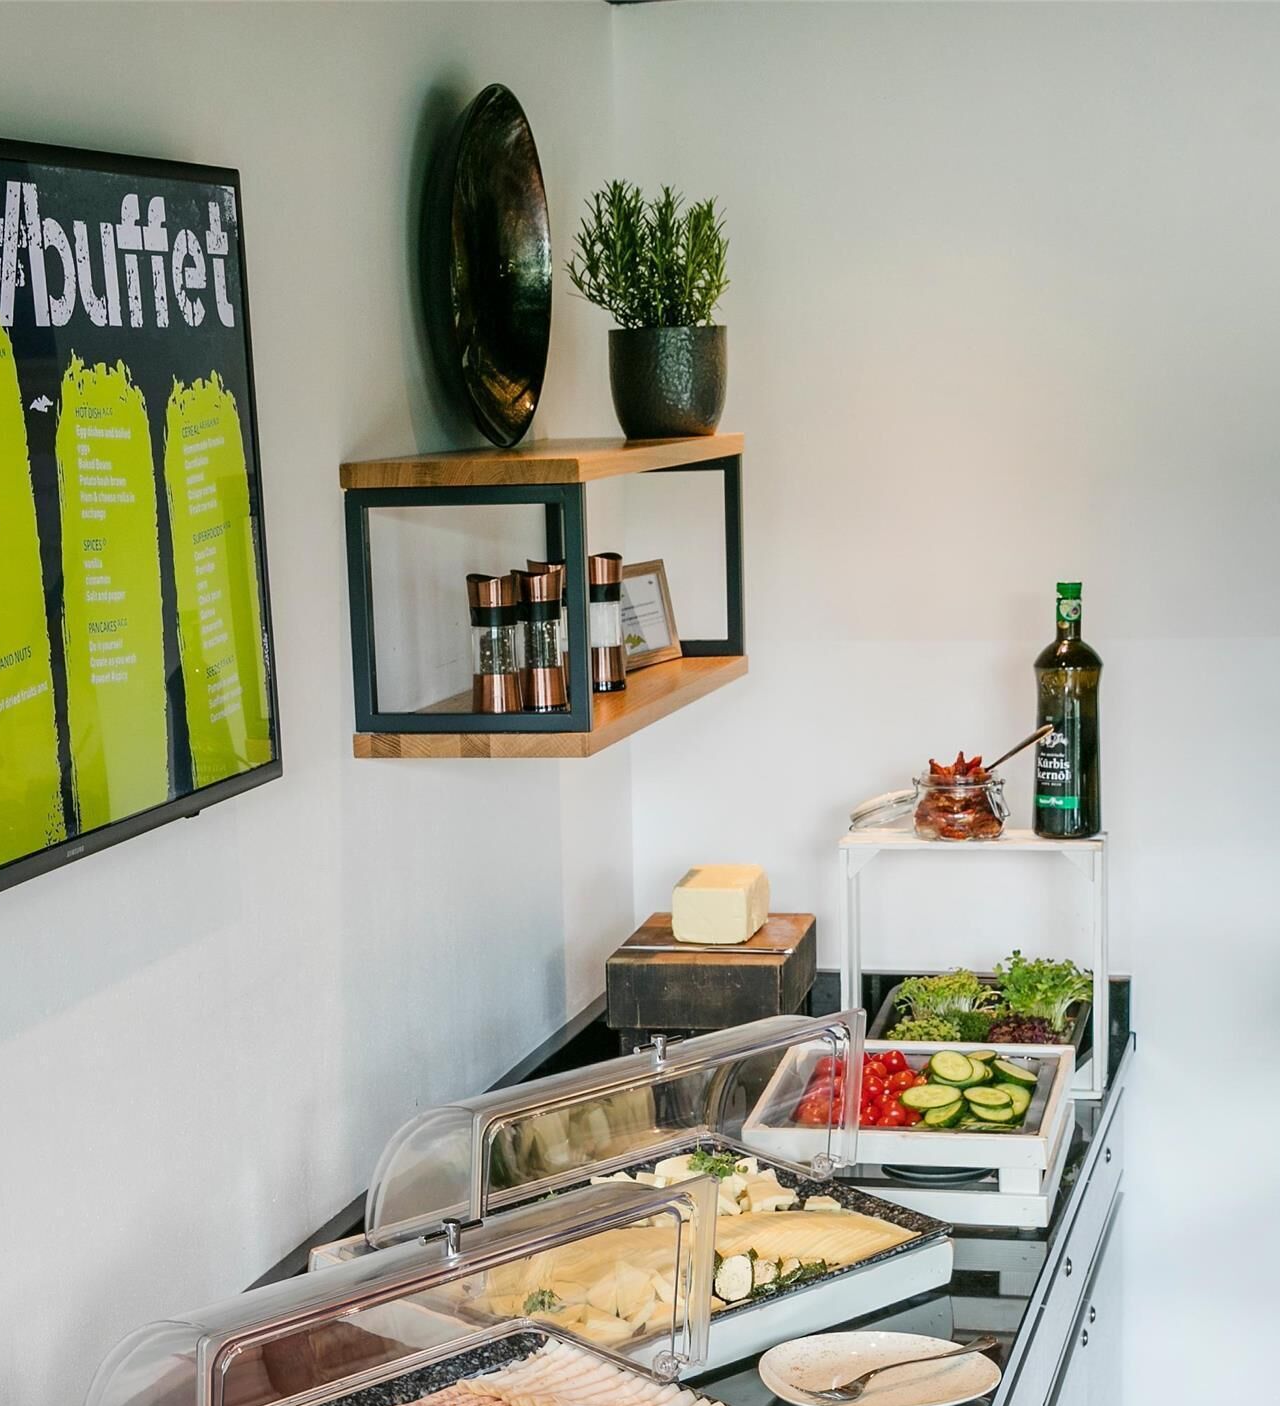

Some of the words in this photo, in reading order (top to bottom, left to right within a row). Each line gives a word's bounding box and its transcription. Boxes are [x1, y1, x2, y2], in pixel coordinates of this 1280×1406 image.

[75, 406, 87, 418] HOT
[83, 538, 102, 551] SPICES
[88, 619, 117, 633] PANCAKES
[0, 653, 14, 669] AND
[14, 645, 32, 665] NUTS
[1037, 757, 1071, 770] Kürbis
[1037, 767, 1071, 780] kernöl
